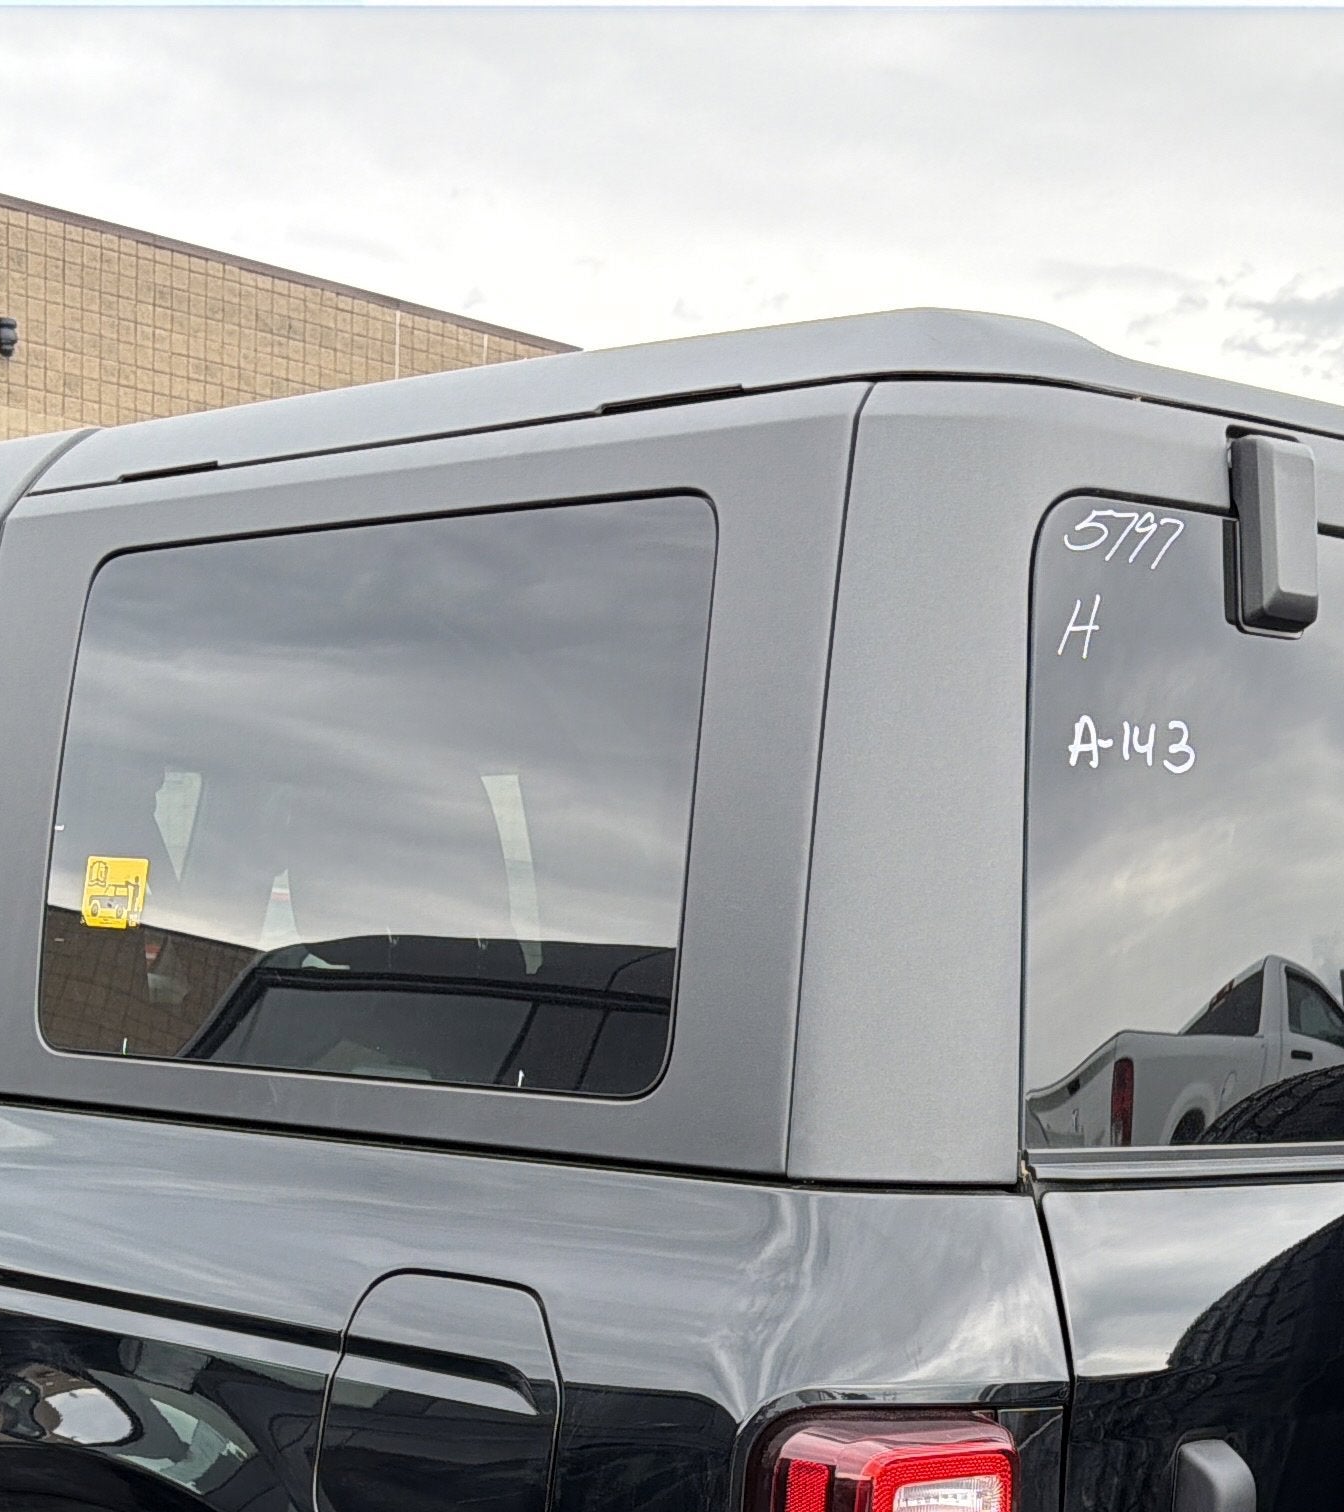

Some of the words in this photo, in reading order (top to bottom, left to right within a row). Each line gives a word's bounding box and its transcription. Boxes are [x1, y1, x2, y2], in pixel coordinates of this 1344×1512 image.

[1064, 510, 1185, 569] 5797
[1057, 594, 1100, 658] H
[1068, 715, 1196, 774] A-143
